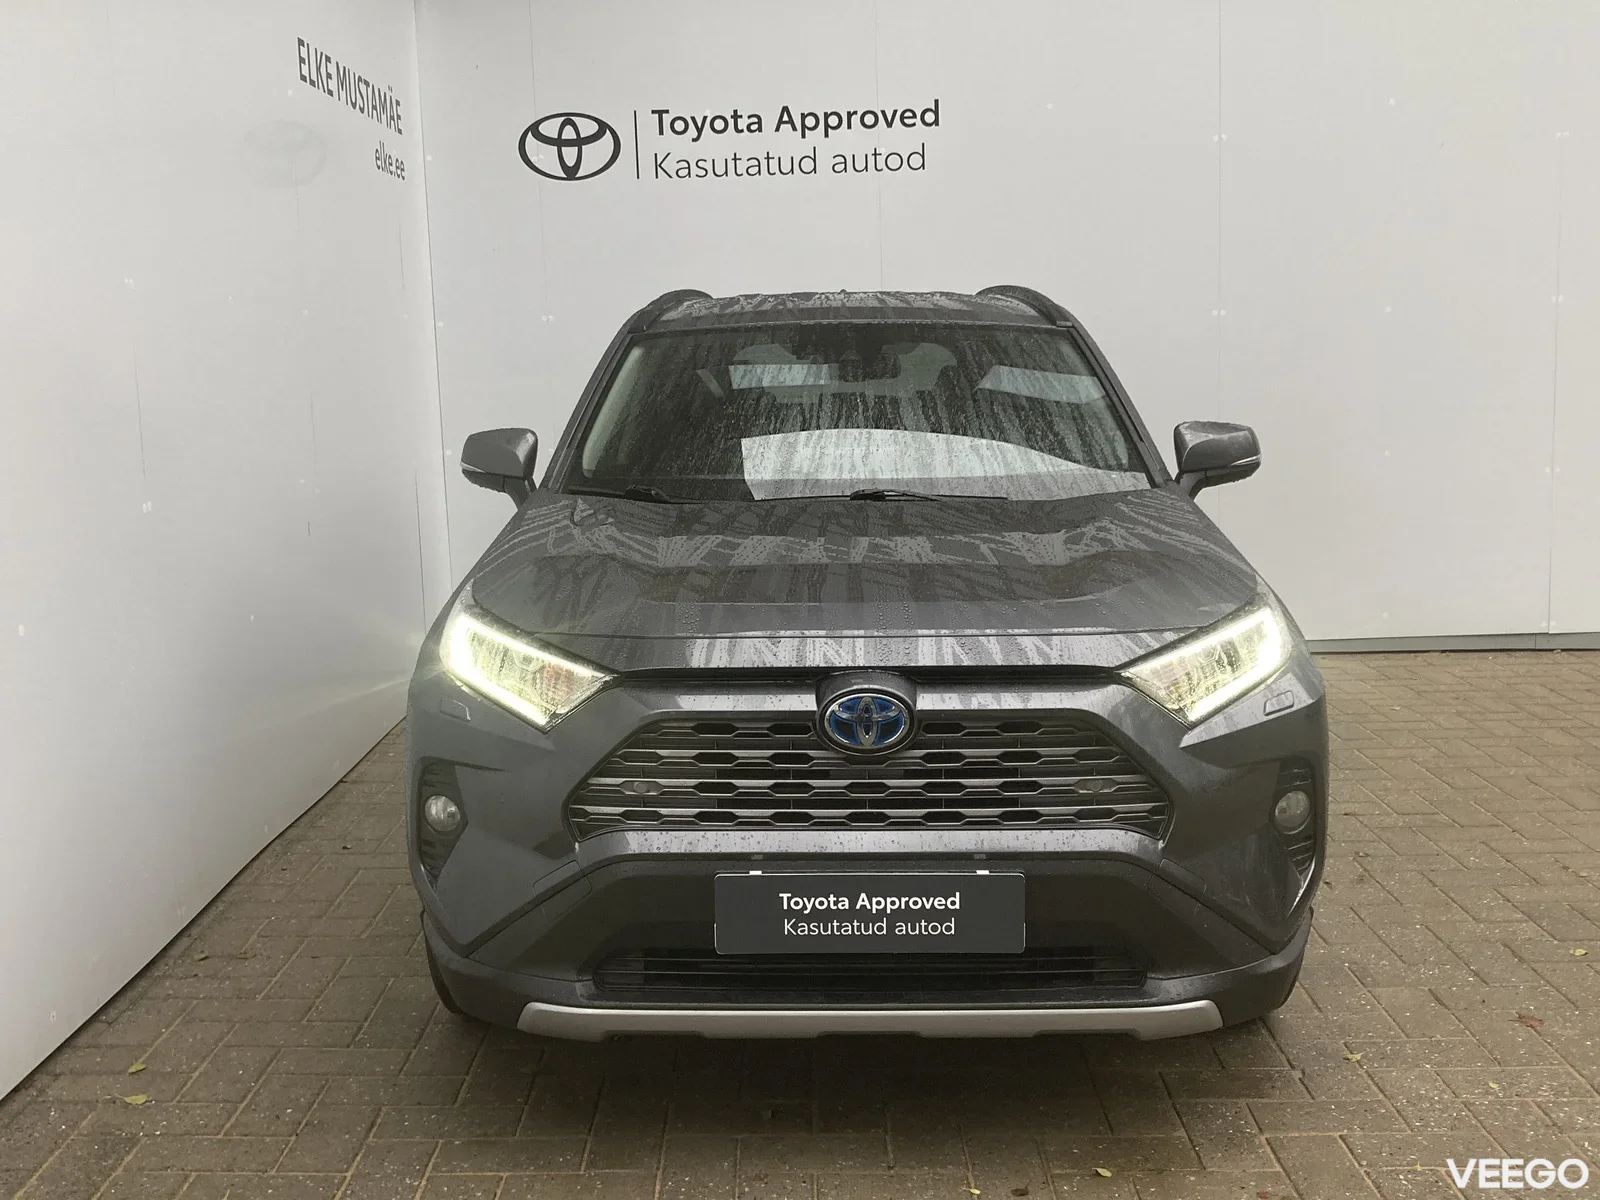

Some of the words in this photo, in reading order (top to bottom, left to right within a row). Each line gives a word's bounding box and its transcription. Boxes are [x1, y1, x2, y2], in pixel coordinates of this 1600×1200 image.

[297, 36, 334, 98] ELKE
[336, 60, 403, 136] MUSTAMÄE
[651, 107, 764, 142] Toyota
[774, 99, 941, 139] Approved
[374, 140, 406, 181] elke.ee
[653, 146, 818, 179] Kasutatud
[831, 143, 927, 173] autod
[779, 893, 850, 914] Toyota
[855, 892, 961, 914] Approved
[783, 917, 887, 936] Kasutatud
[895, 917, 956, 935] autod
